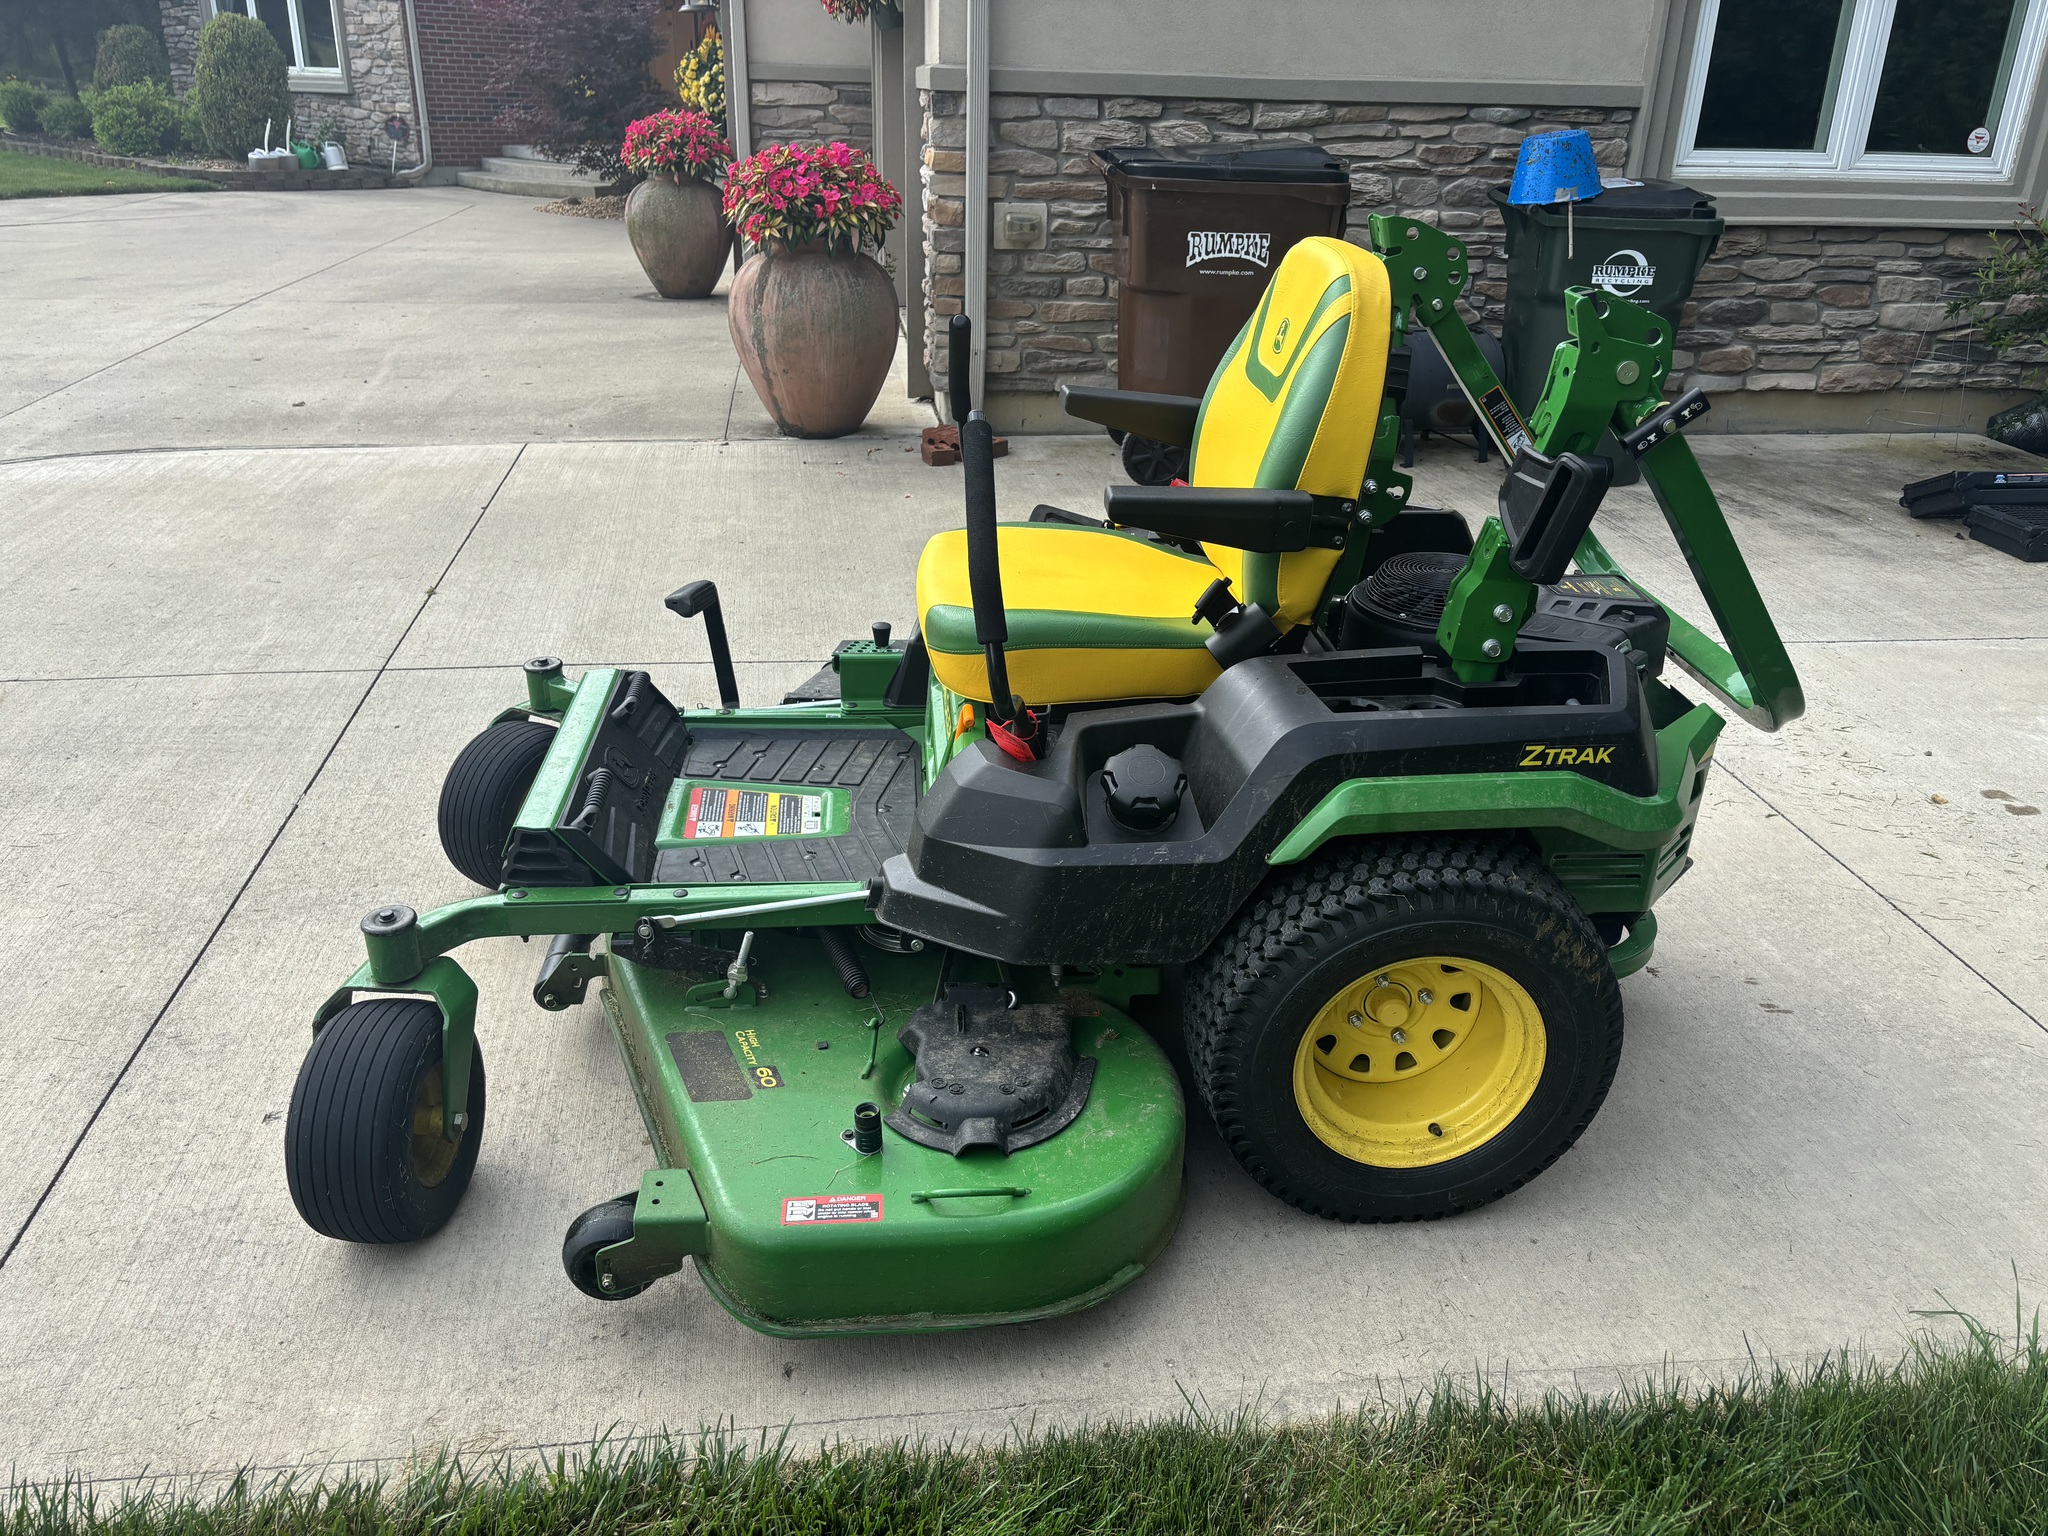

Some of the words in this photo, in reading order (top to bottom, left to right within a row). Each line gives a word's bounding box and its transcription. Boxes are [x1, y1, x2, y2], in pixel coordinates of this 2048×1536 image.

[1186, 231, 1271, 268] RUMPKE
[1199, 269, 1254, 277] www.rumpke.com
[1592, 264, 1656, 278] RUMPKE
[1519, 745, 1616, 767] ZTRAK
[735, 1030, 758, 1066] CAPACITY
[745, 1029, 760, 1048] HIGH
[756, 1067, 777, 1088] 60
